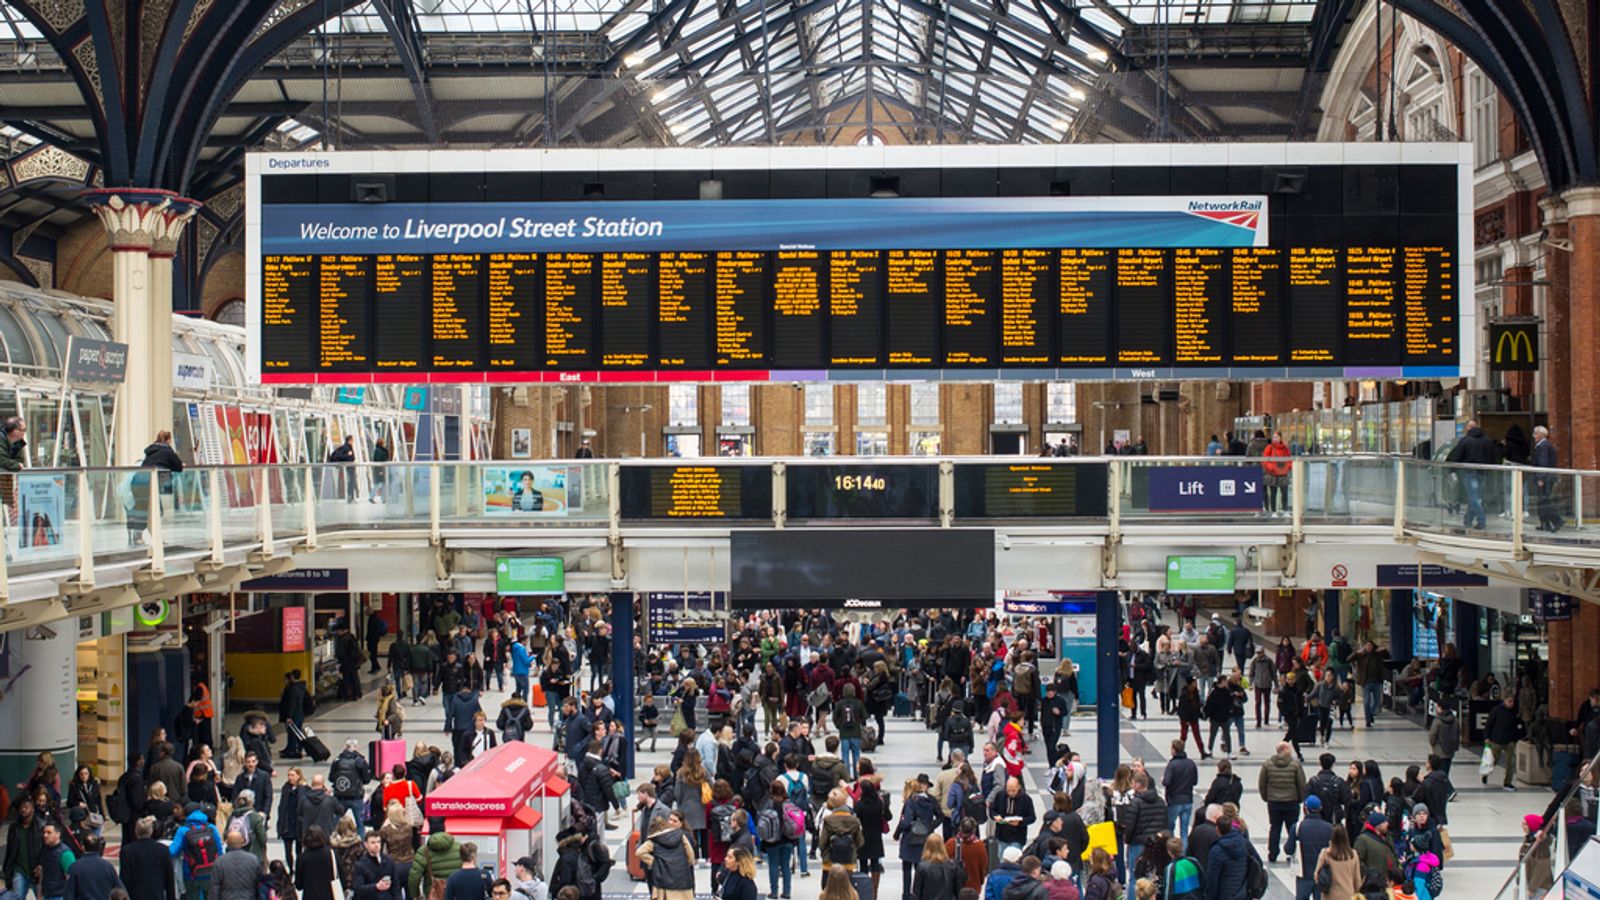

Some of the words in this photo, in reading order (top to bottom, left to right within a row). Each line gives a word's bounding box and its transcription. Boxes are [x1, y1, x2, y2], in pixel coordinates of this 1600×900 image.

[268, 158, 330, 169] Departures
[300, 222, 378, 240] Welcome
[382, 224, 400, 240] to
[404, 217, 504, 244] Liverpool
[510, 217, 578, 238] Street
[582, 216, 663, 237] Station
[560, 373, 581, 382] East
[1131, 369, 1156, 378] West
[1179, 481, 1204, 495] Lift
[844, 599, 882, 608] JCDecaux
